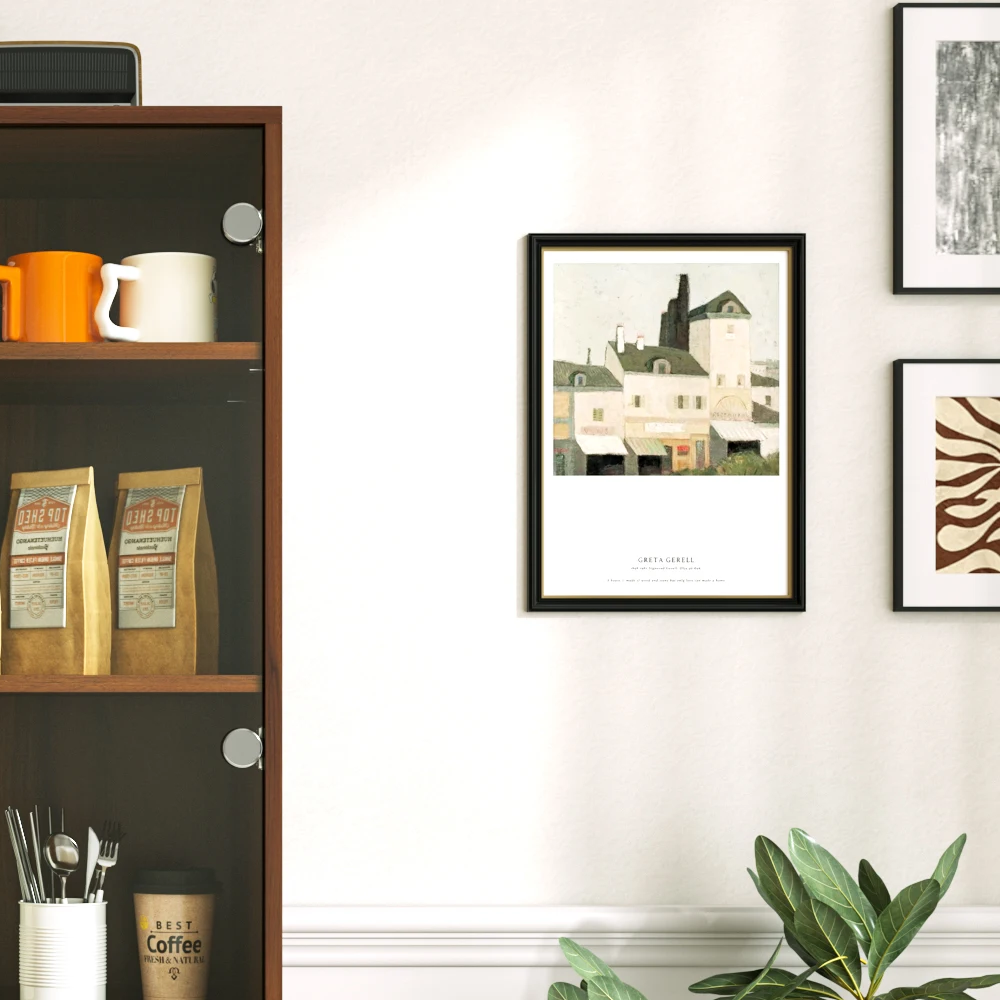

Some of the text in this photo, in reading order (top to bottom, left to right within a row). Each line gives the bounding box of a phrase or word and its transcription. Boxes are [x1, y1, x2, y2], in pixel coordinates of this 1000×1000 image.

[638, 556, 694, 564] GRETA GERELL
[156, 921, 192, 930] BEST
[147, 935, 202, 954] Coffee
[144, 955, 164, 964] FRESH
